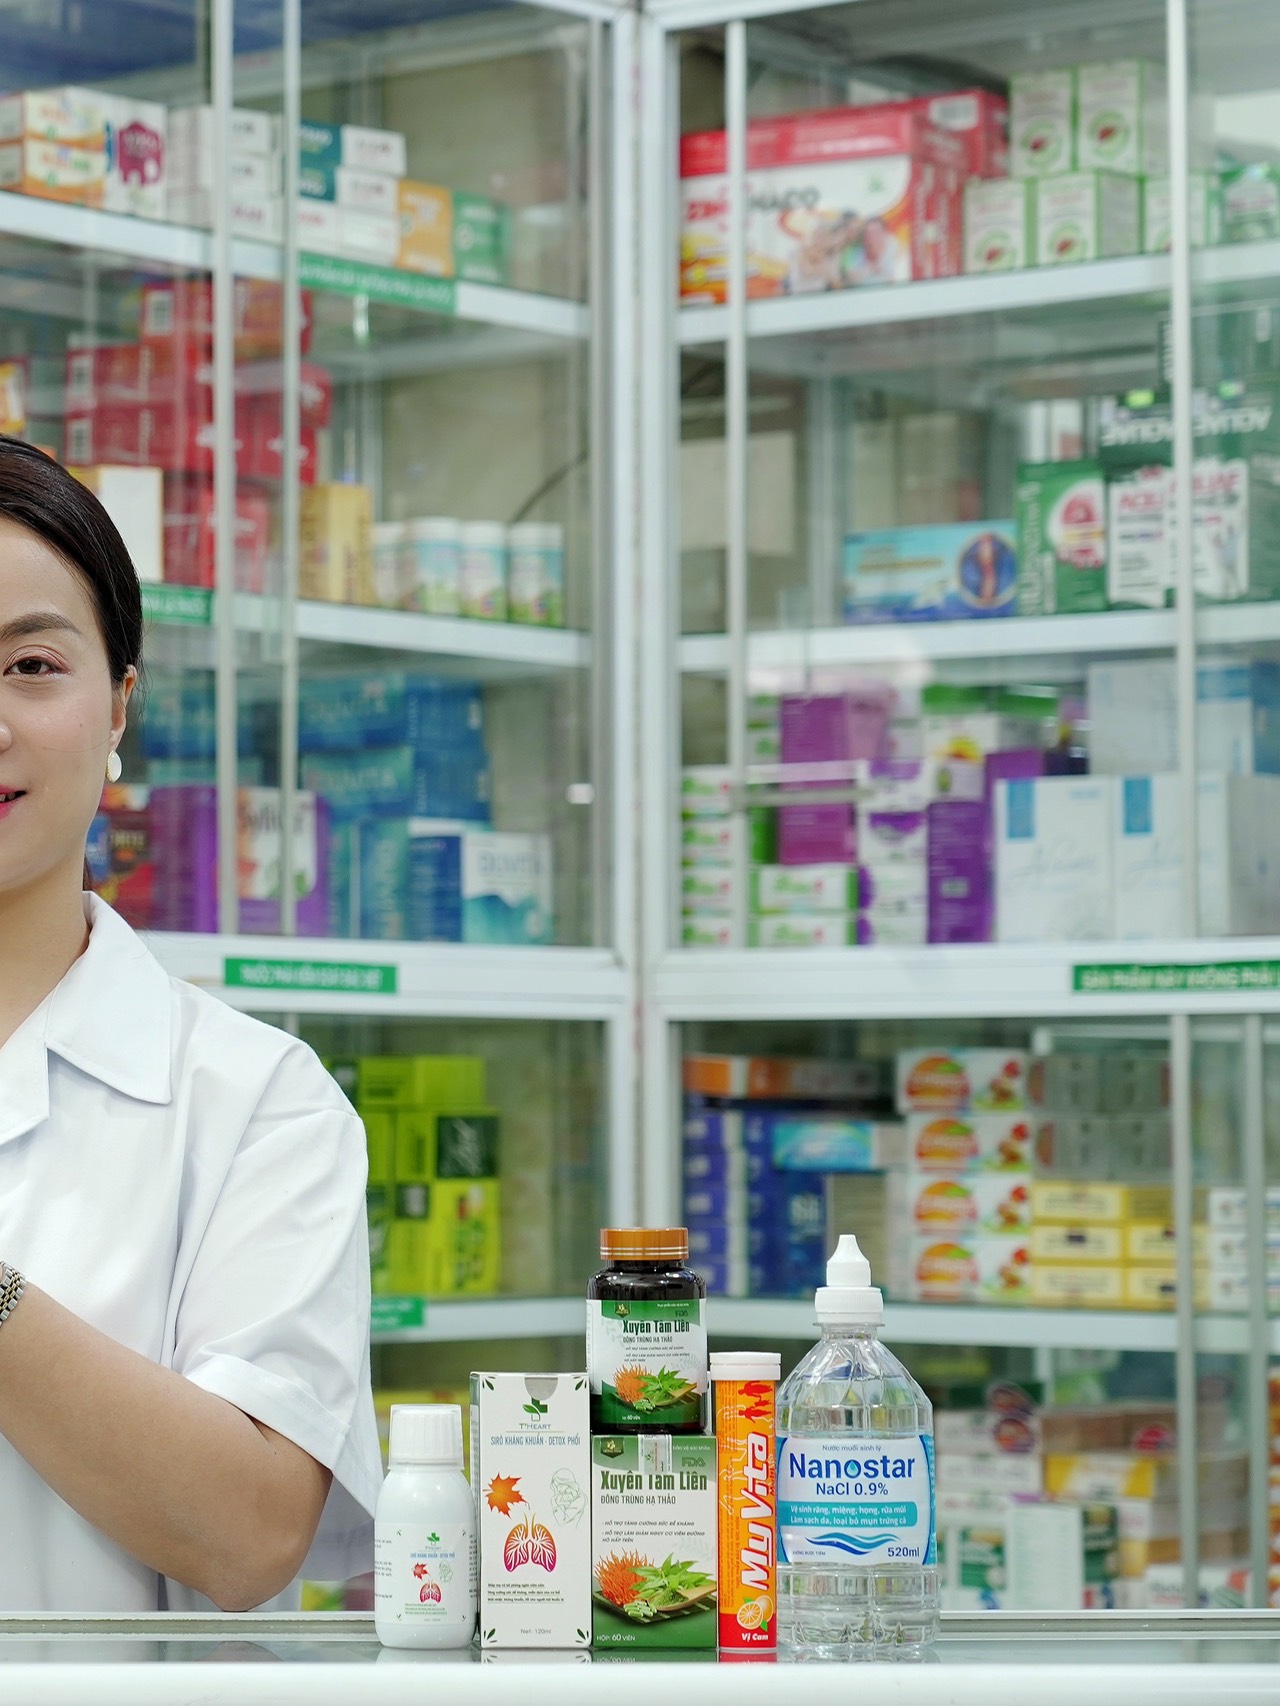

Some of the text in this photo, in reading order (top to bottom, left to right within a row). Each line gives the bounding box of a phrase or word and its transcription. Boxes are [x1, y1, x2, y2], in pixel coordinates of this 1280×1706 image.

[623, 1318, 690, 1336] Xuyên Tâm Liên
[505, 1434, 524, 1446] KHÁNG
[525, 1431, 544, 1446] KHUẨN
[549, 1436, 566, 1446] DETOX
[568, 1433, 581, 1446] PHỔI
[681, 1456, 707, 1467] FDA
[789, 1452, 916, 1479] Nanostar
[600, 1470, 643, 1494] Xuyên
[679, 1470, 707, 1491] Liên
[816, 1482, 889, 1496] NaCl 0.9%
[600, 1493, 676, 1506] ĐÔNG TRÙNG HẠ THẢO
[740, 1431, 774, 1591] MyVita
[791, 1505, 798, 1514] Vệ
[799, 1505, 812, 1513] sinh
[813, 1505, 831, 1516] răng,
[832, 1505, 858, 1516] miệng,
[859, 1505, 880, 1516] họng,
[790, 1516, 803, 1524] Làm
[804, 1516, 820, 1526] sạch
[820, 1516, 832, 1526] da,
[833, 1516, 848, 1526] loại
[849, 1515, 859, 1525] bỏ
[860, 1517, 878, 1526] mụn
[879, 1516, 899, 1526] trứng
[887, 1547, 920, 1557] 520ml
[611, 1633, 621, 1642] 60
[621, 1633, 636, 1642] VIÊN
[742, 1633, 769, 1643] Vị Cam
